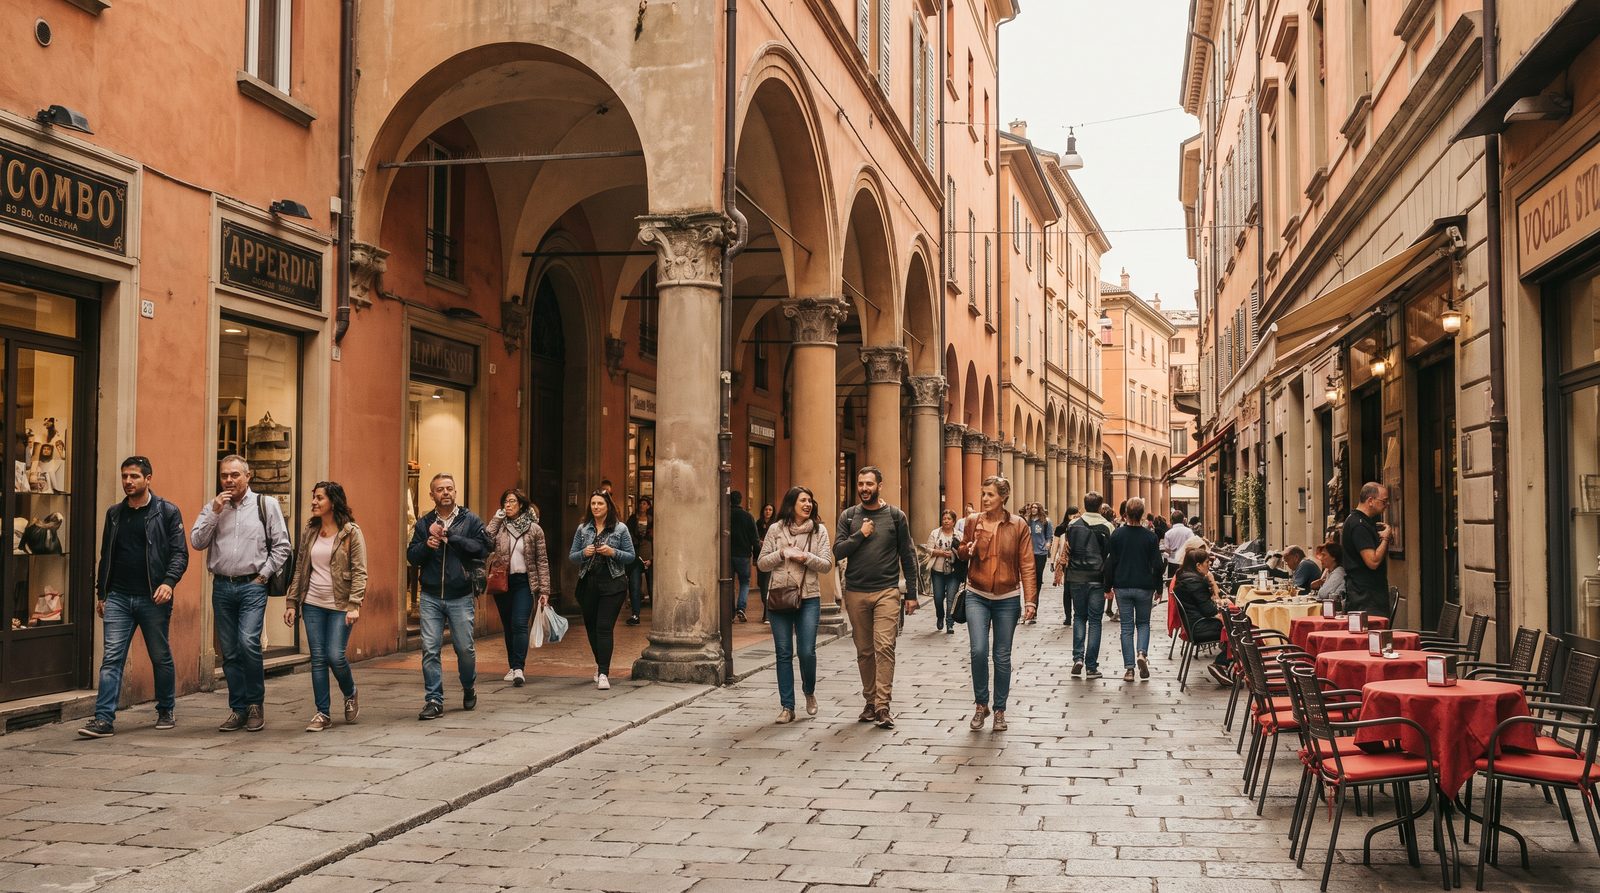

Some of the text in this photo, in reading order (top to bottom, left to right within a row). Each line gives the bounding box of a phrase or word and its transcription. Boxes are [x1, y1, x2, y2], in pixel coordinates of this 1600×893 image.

[0, 154, 115, 228] COMBO
[1524, 185, 1571, 254] VOGLIA
[229, 235, 316, 289] APPERDIA
